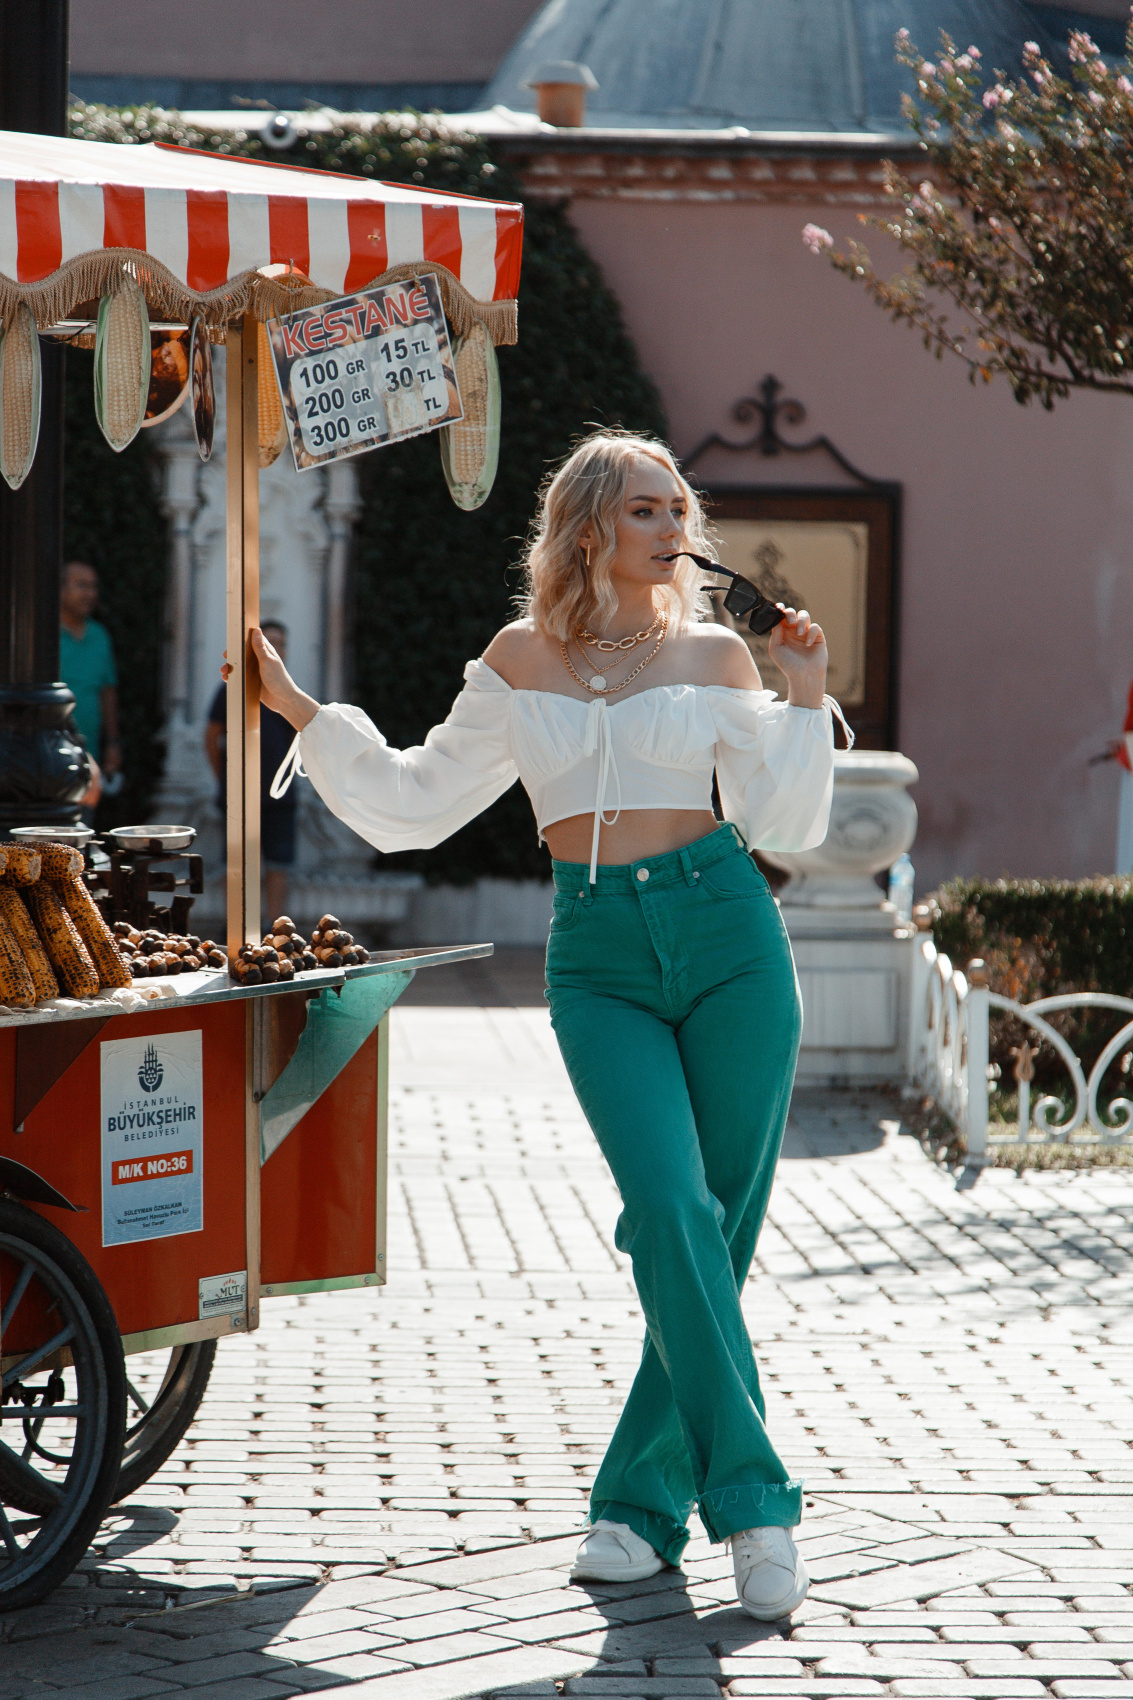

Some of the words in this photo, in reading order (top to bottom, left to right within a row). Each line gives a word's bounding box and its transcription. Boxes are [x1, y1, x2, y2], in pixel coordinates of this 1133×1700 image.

[282, 286, 430, 357] KESTANE
[299, 359, 339, 389] 100
[345, 359, 366, 375] GR
[380, 338, 409, 364] 15
[411, 340, 431, 355] TL
[304, 388, 345, 419] 200
[351, 387, 372, 404] GR
[385, 366, 414, 393] 30
[417, 368, 436, 384] TL
[310, 416, 350, 448] 300
[357, 416, 377, 433] GR
[424, 397, 442, 412] TL
[108, 1102, 196, 1132] BÜYÜKŞEHİR
[124, 1096, 179, 1110] İSTANBUL
[124, 1126, 179, 1142] BELEDİYESİ
[118, 1162, 144, 1179] M/K
[147, 1156, 187, 1175] NO:36
[220, 1285, 240, 1297] MUT
